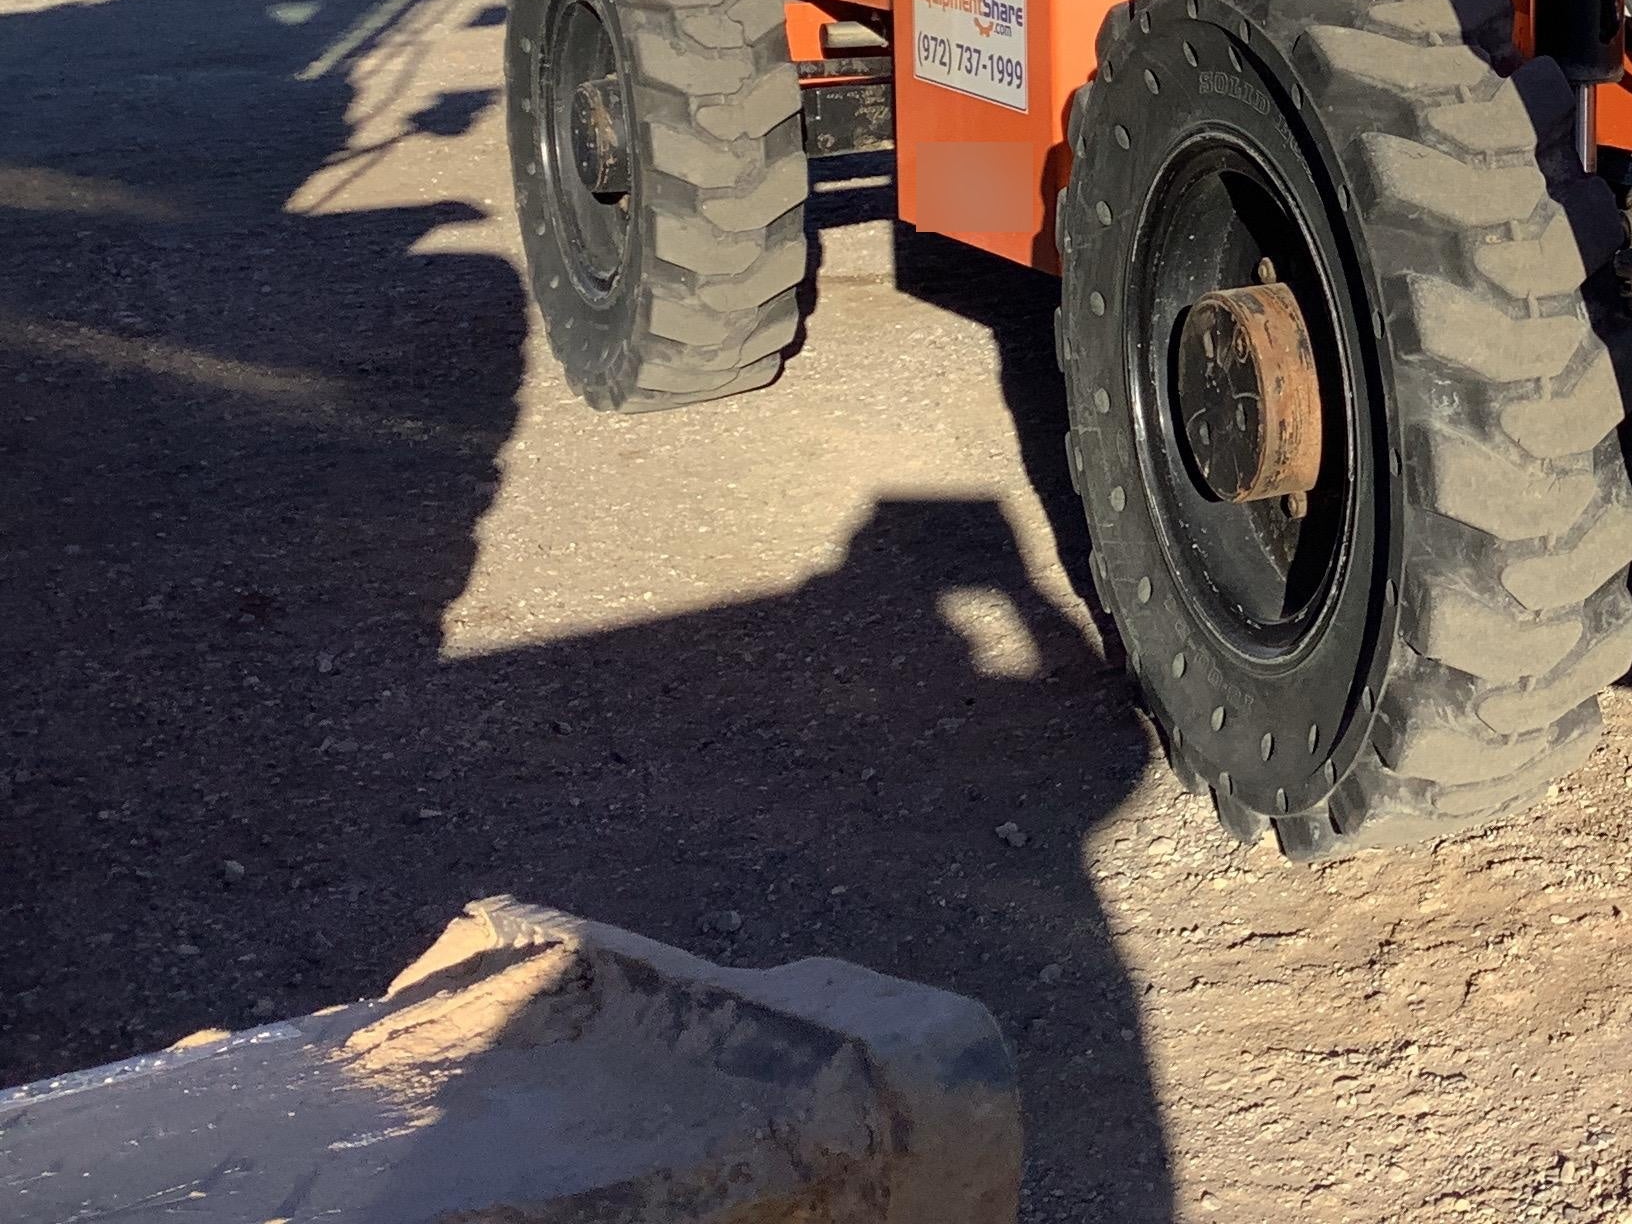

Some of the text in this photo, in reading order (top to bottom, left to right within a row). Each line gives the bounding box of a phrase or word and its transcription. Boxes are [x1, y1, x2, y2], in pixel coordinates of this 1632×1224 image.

[917, 31, 1024, 90] (972) 737-1999
[1199, 71, 1271, 115] SOLID
